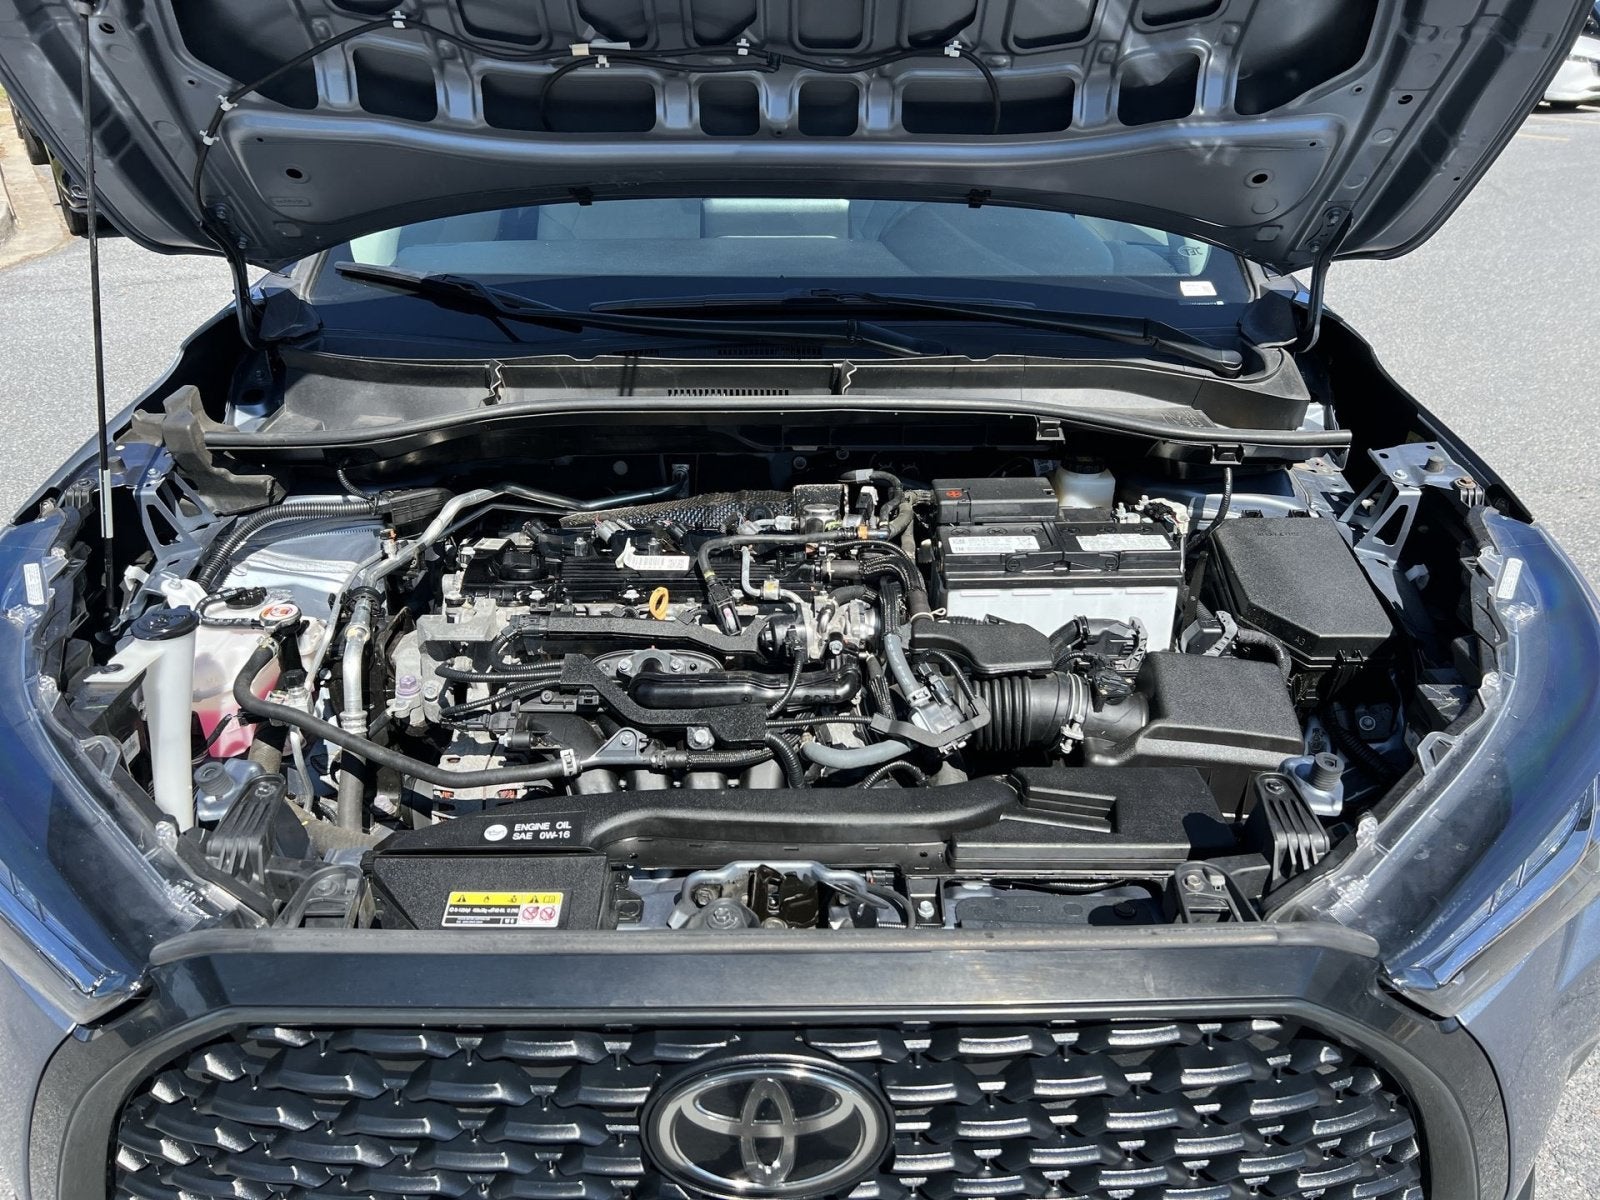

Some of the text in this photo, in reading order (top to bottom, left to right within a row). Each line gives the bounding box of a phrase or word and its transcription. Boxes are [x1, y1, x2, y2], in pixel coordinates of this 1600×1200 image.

[514, 821, 572, 831] ENGINE OIL
[512, 830, 571, 841] SAE 0W-16
